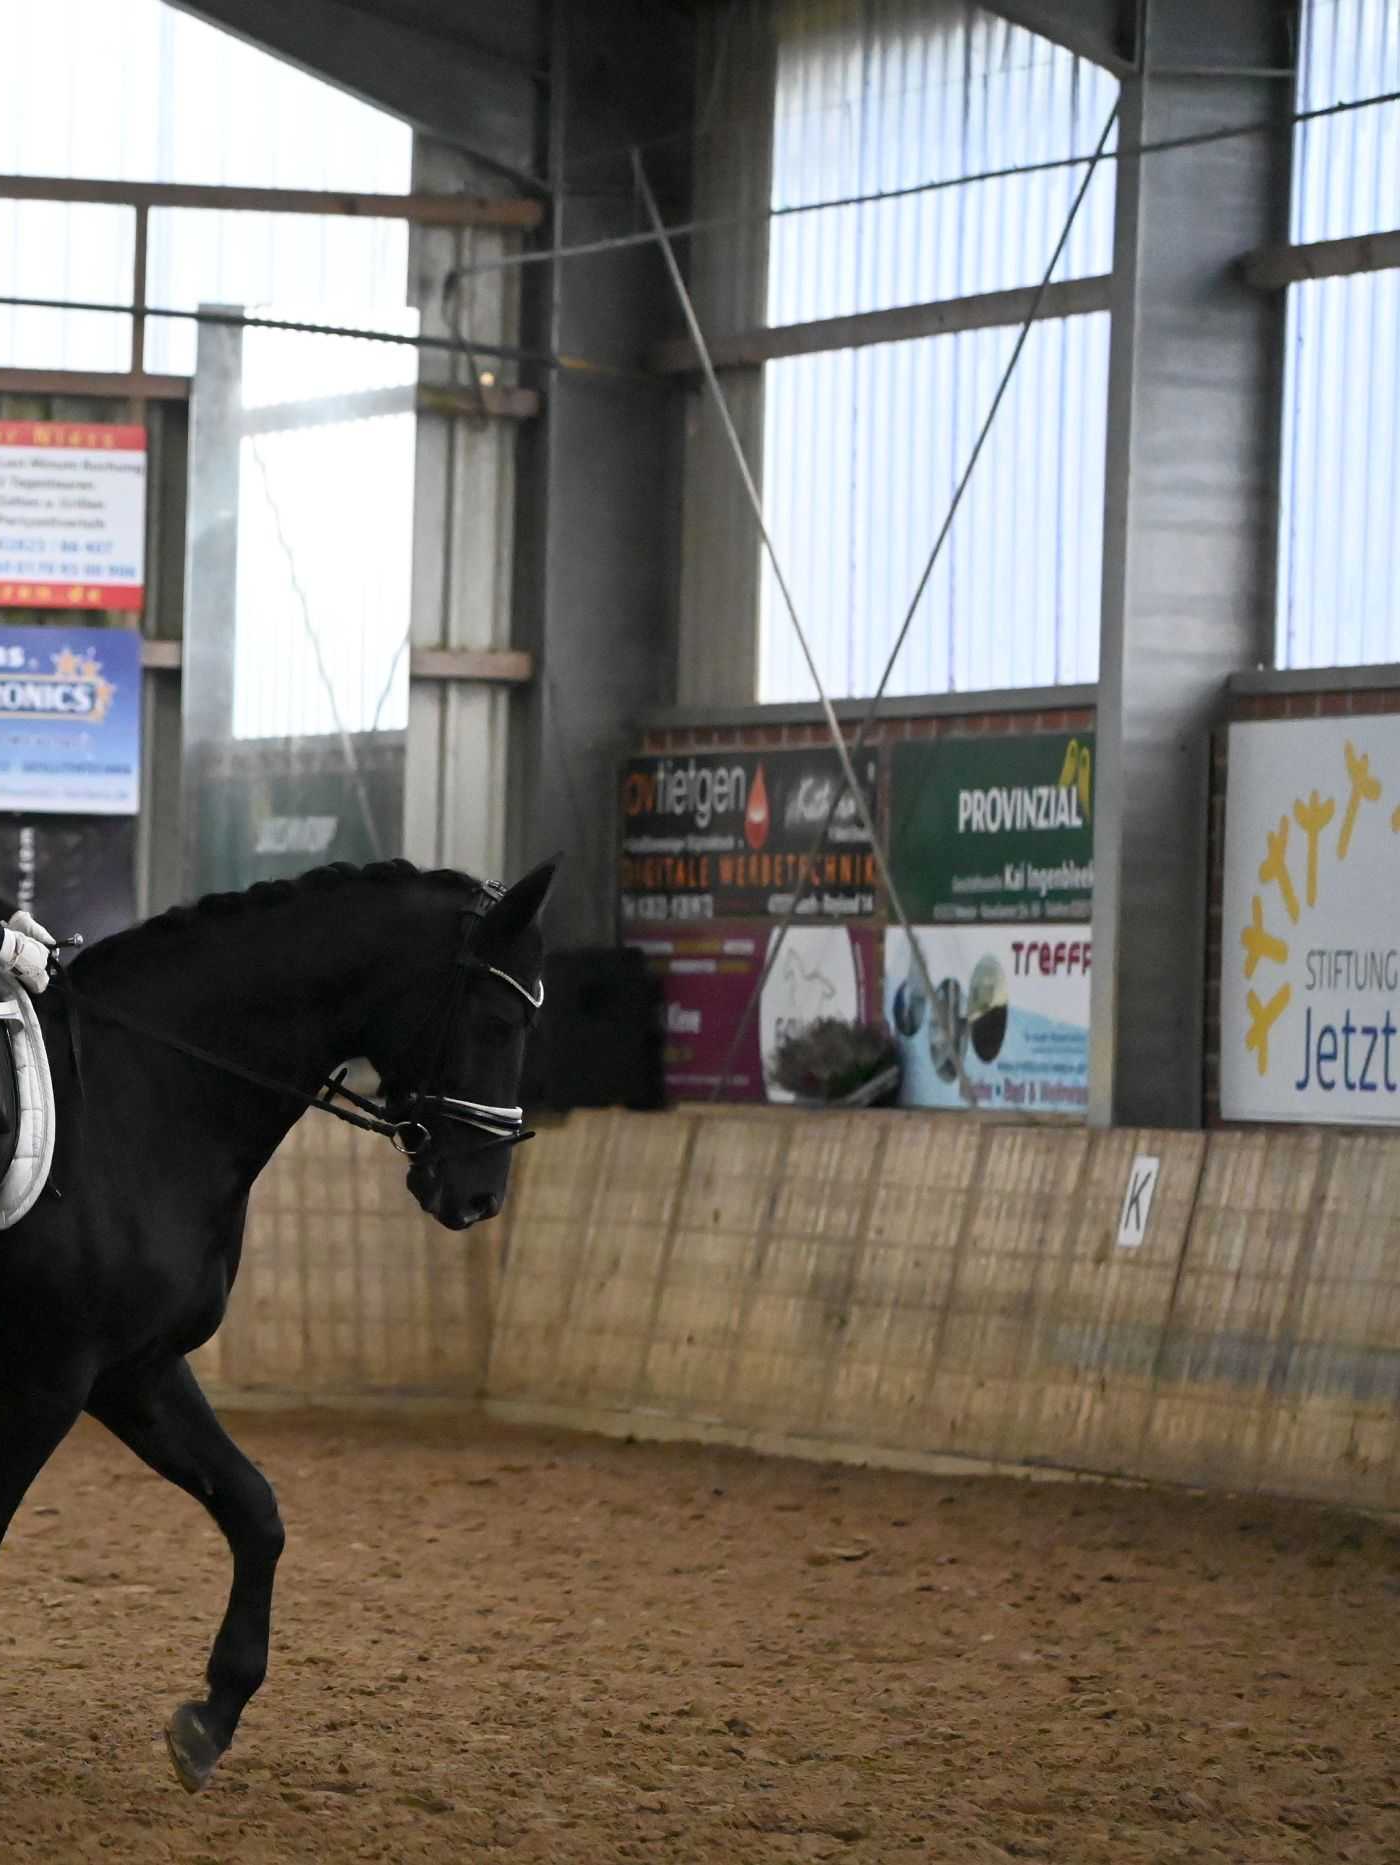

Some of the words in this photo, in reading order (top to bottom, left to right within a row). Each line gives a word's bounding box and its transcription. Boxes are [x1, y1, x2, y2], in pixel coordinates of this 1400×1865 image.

[957, 784, 1084, 835] PROVINZIAL
[1305, 949, 1399, 992] STIFTUNG
[1295, 1007, 1399, 1094] Jetzt
[1123, 1170, 1152, 1232] K
